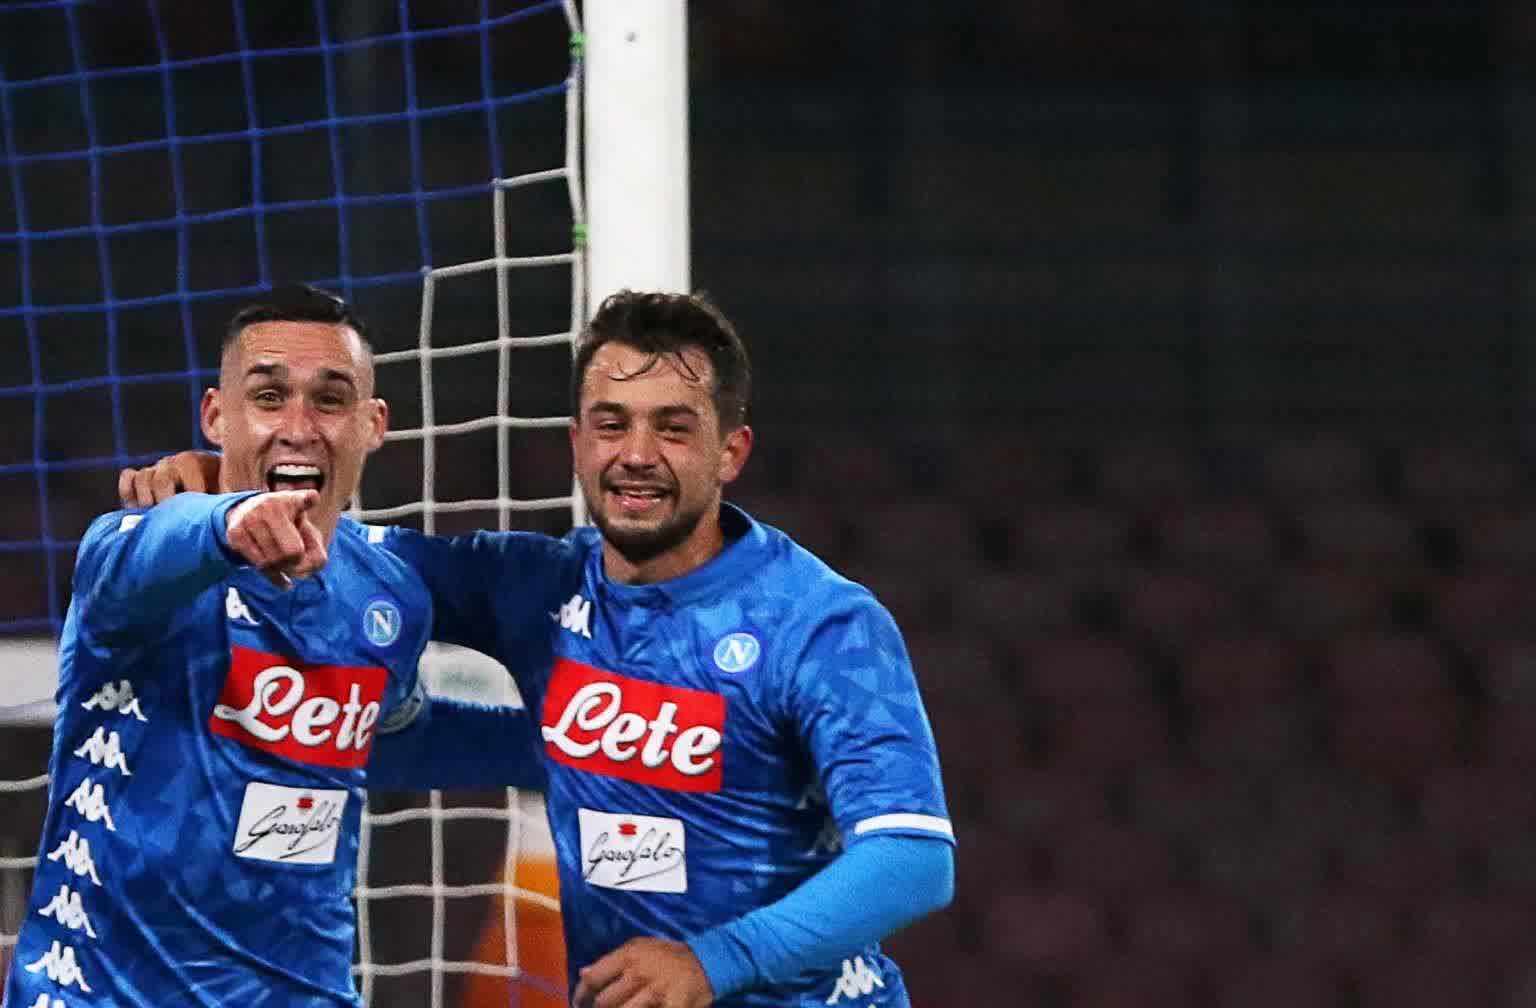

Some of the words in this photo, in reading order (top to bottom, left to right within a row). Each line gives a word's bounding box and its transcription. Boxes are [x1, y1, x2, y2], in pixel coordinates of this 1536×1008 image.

[370, 609, 393, 639] N
[719, 639, 754, 666] N
[214, 666, 380, 749] Lete
[541, 682, 721, 775] Lete
[584, 827, 686, 885] Garofalo
